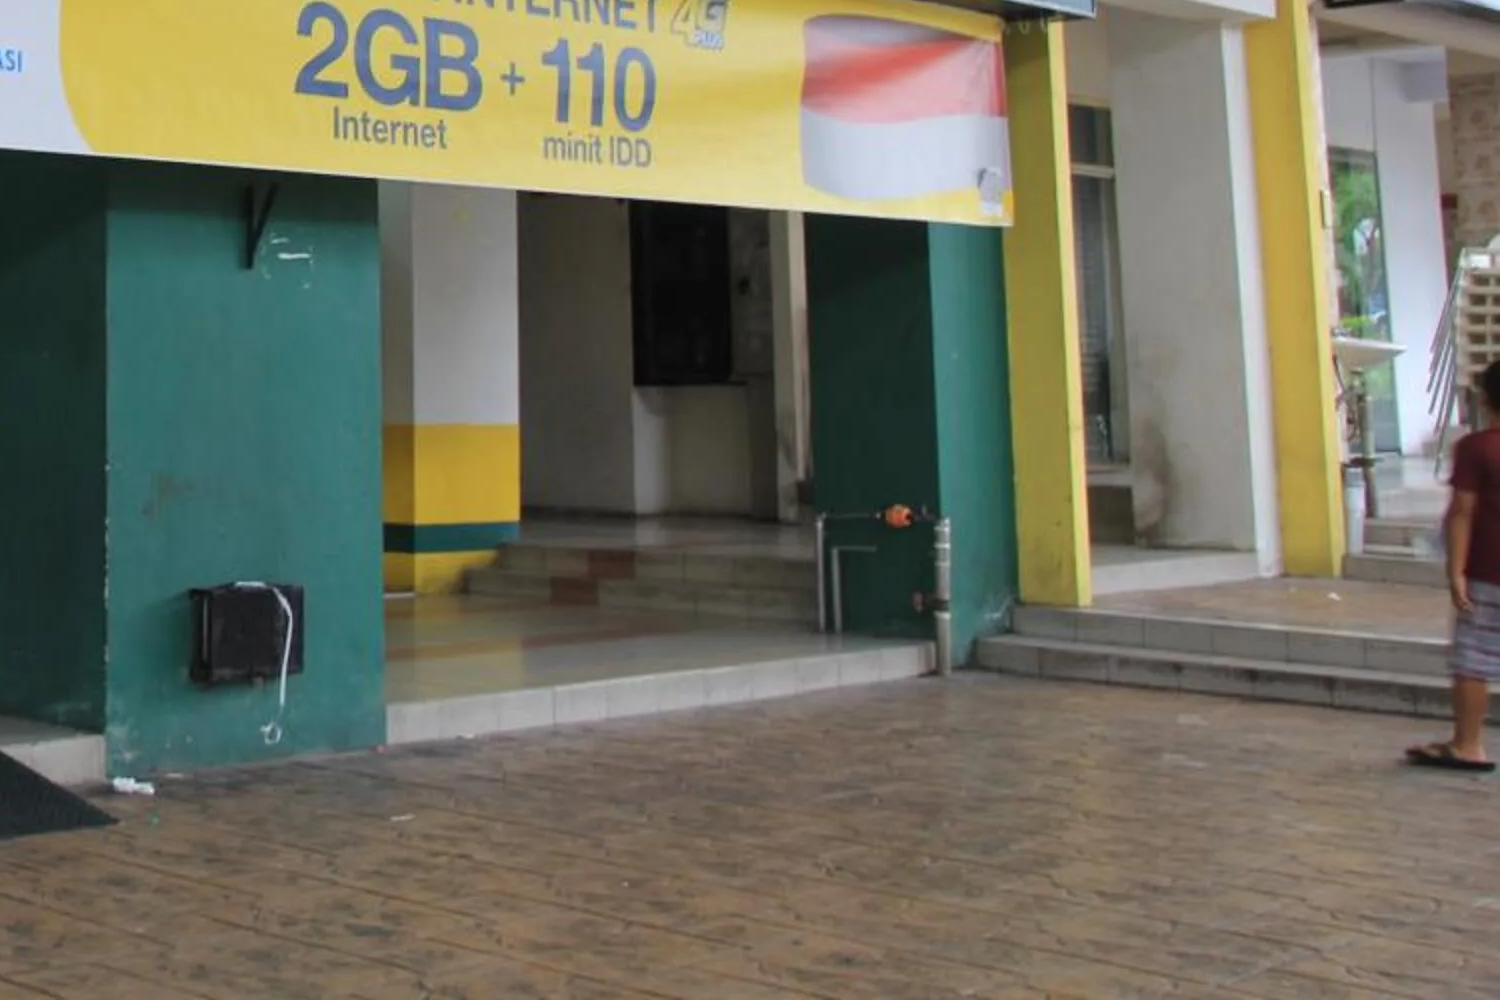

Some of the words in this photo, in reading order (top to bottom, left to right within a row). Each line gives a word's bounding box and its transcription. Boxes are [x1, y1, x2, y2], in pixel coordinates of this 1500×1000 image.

[294, 1, 483, 112] 2GB
[500, 61, 525, 95] +
[541, 37, 657, 133] 110
[333, 106, 448, 149] Internet
[543, 132, 602, 165] minit
[608, 134, 652, 168] IDD
